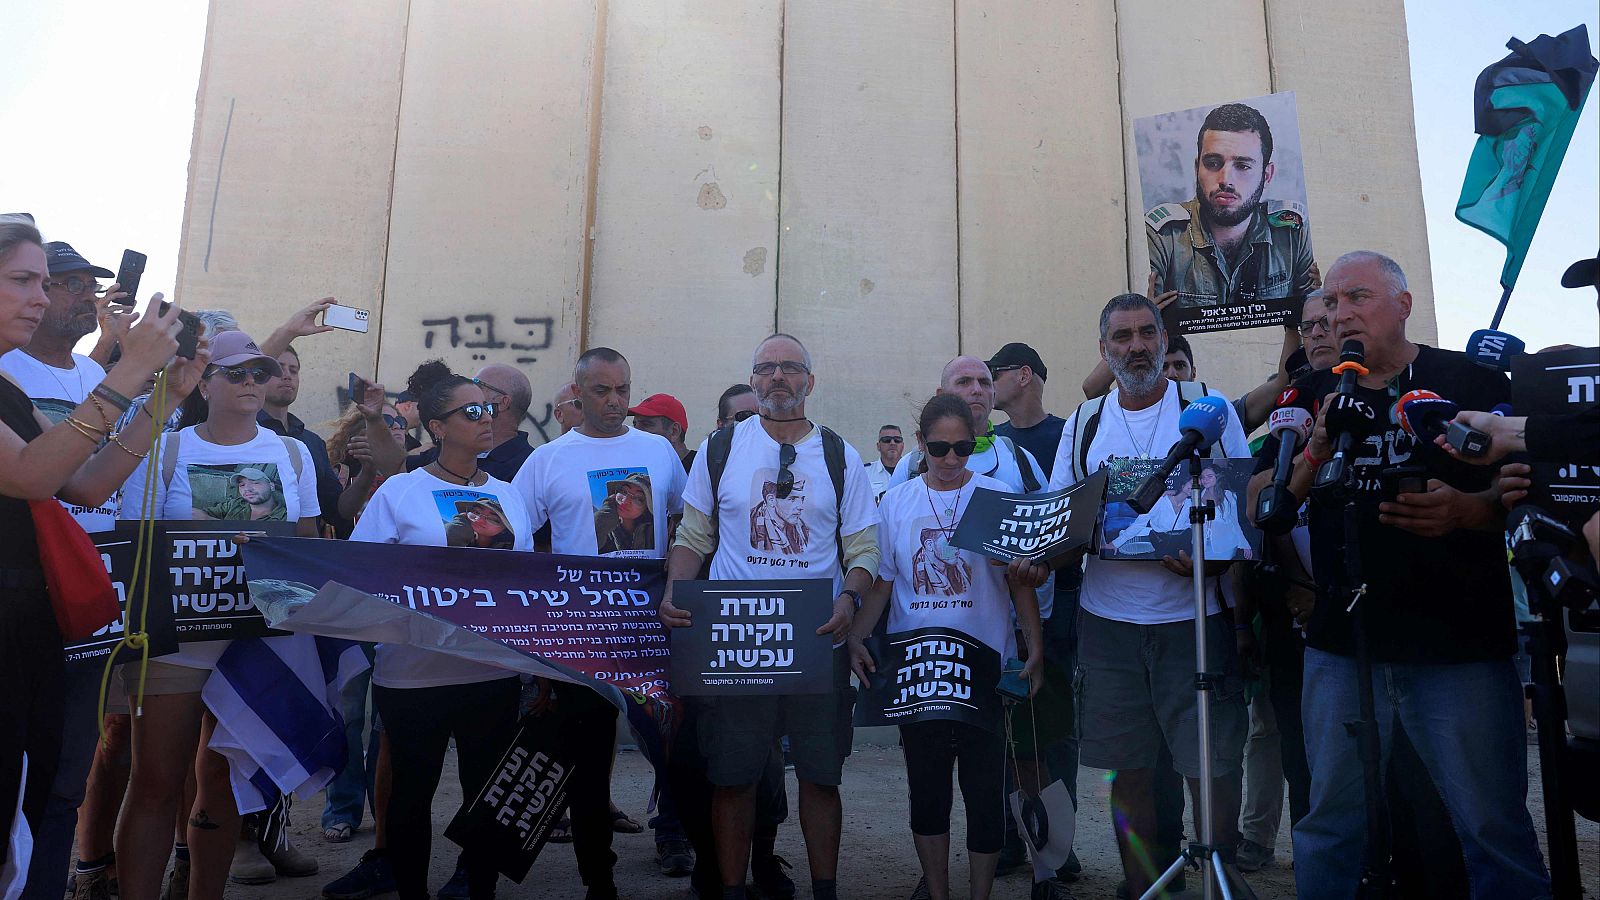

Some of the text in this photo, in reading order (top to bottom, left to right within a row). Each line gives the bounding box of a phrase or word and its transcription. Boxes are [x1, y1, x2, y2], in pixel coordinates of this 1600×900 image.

[1201, 303, 1266, 317] רס"ן רועי צ'אפל
[1338, 395, 1375, 419] כאן
[596, 470, 615, 480] ביטון
[443, 490, 463, 499] ביטון
[1552, 493, 1588, 503] באוקטובר
[1013, 496, 1071, 517] ועדת
[999, 509, 1072, 534] חקירה
[992, 525, 1068, 551] עכשיו.
[172, 539, 238, 559] עדת
[747, 555, 767, 566] ברעם
[769, 557, 786, 567] נטע
[557, 565, 641, 583] לזכרה של
[403, 584, 497, 609] ביטון
[507, 589, 570, 607] שיר
[581, 586, 650, 607] סמל
[720, 597, 785, 617] ועדת
[909, 600, 930, 611] ברעם
[932, 600, 949, 610] נטע
[567, 610, 586, 618] נחל
[590, 610, 622, 618] במוצב
[624, 609, 657, 617] שירתה
[470, 621, 662, 633] כחובשת קרבית בחטיבה הצפונית של
[605, 635, 635, 644] מצוות
[638, 634, 666, 644] כחלק
[711, 622, 793, 646] חקירה
[532, 637, 564, 646] טיפול
[568, 637, 603, 645] בניידת
[82, 648, 111, 659] משפחות
[543, 650, 586, 659] מחבלים
[588, 650, 607, 658] מול
[610, 650, 638, 659] בקרב
[641, 647, 671, 657] ונפלה
[905, 639, 965, 661] ועדת
[710, 648, 794, 668] עכשיו.
[896, 660, 971, 685] חקירה
[746, 677, 774, 685] משפחות
[893, 681, 971, 706] עכשיו.
[884, 709, 913, 718] באוקטובר
[925, 704, 951, 712] משפחות
[484, 746, 529, 807] ועדת
[495, 751, 549, 826] חקירה
[516, 762, 564, 838] עכשיו.
